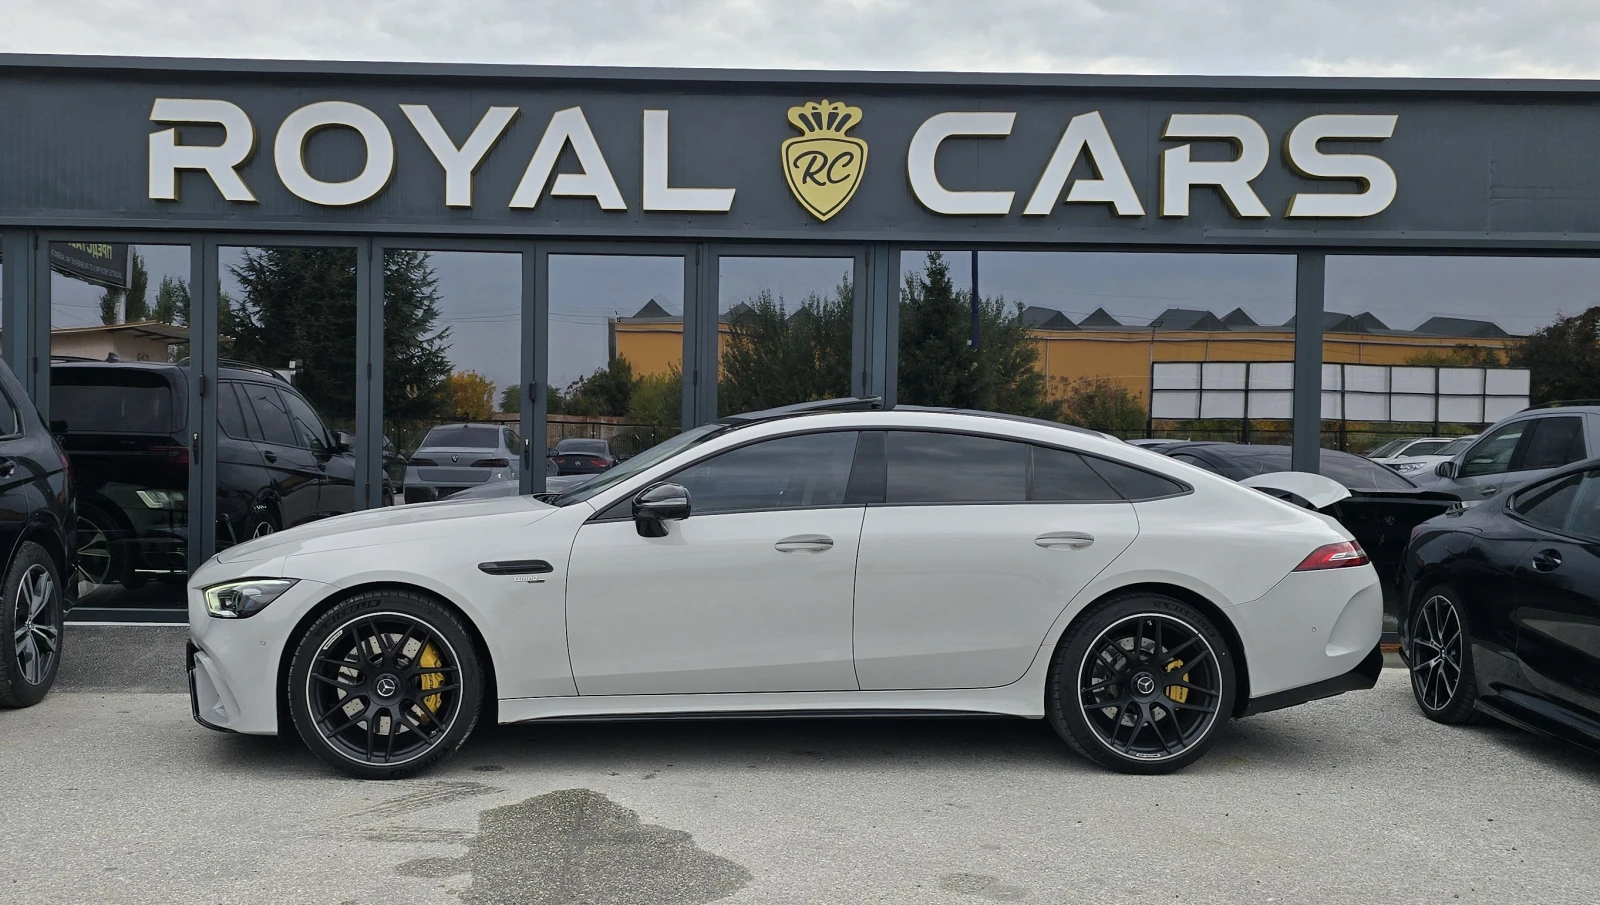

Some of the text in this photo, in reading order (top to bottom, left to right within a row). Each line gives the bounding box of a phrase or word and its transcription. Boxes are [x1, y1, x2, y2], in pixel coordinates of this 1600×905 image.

[149, 99, 1398, 216] ROYAL CARS
[793, 150, 854, 187] RC
